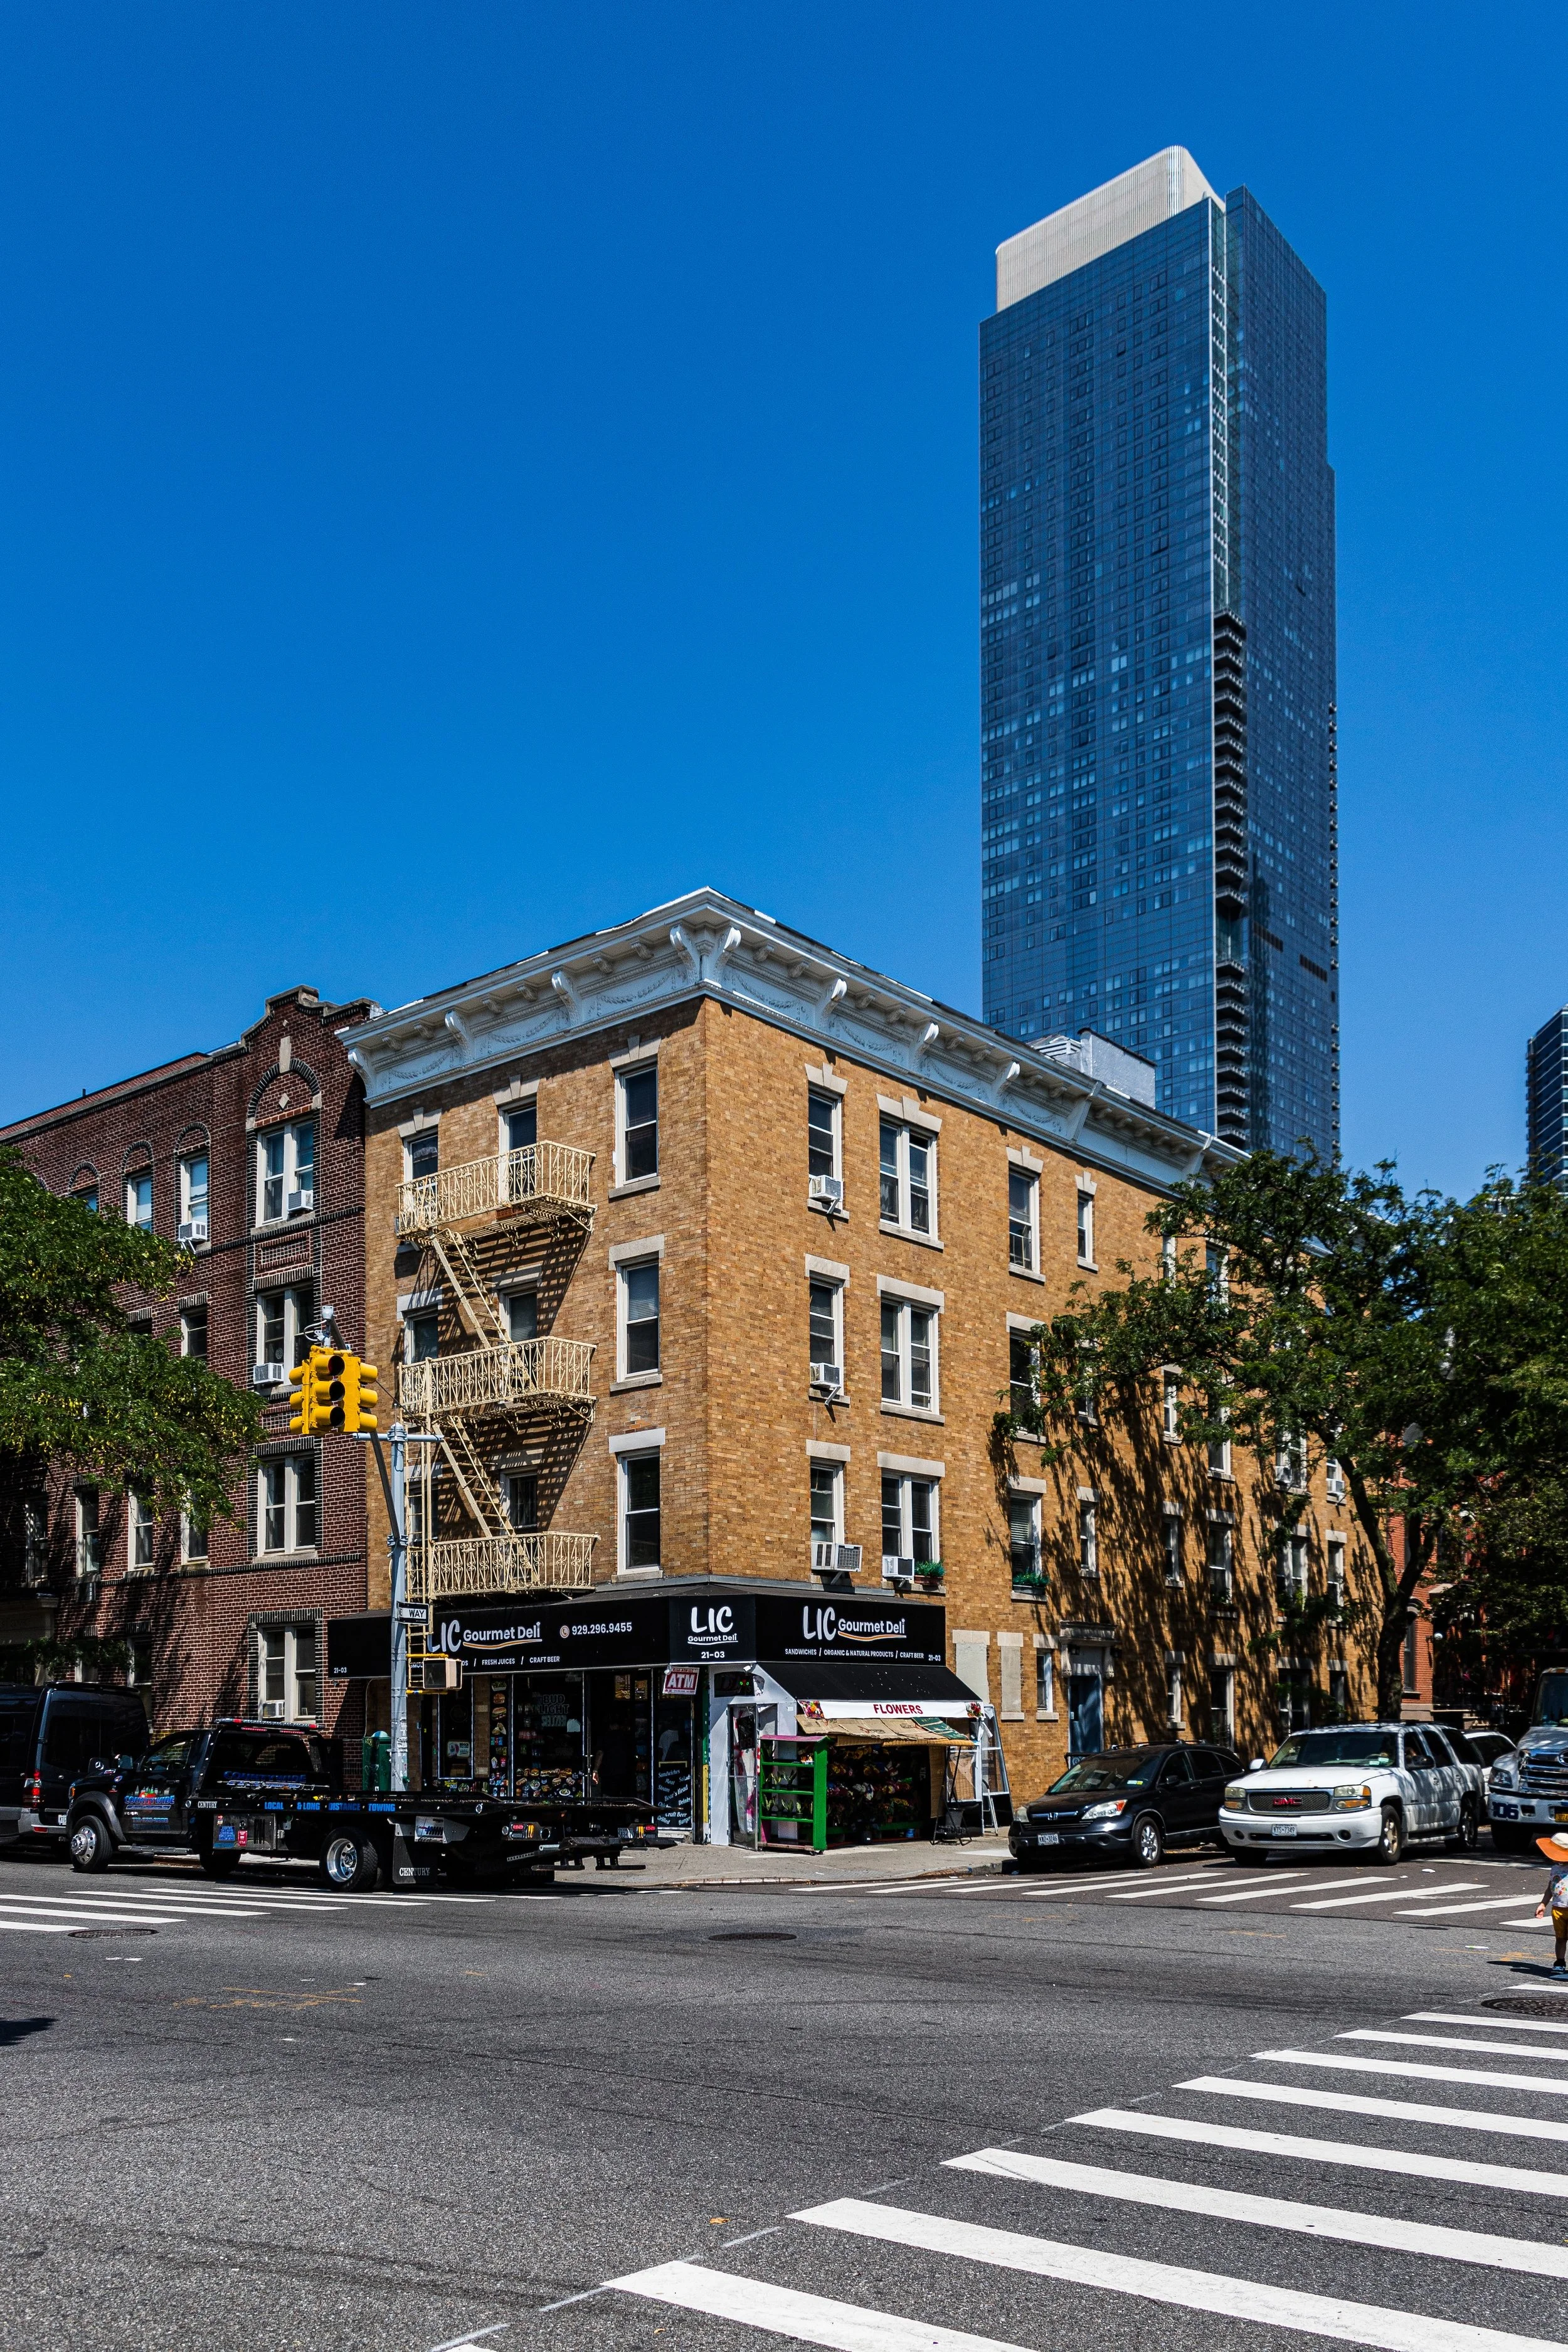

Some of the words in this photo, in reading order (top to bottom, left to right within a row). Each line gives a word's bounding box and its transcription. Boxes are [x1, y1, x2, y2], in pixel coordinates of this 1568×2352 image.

[409, 1609, 425, 1618] WAY
[691, 1606, 733, 1633] LIC
[571, 1622, 632, 1635] 929.296.9455
[803, 1606, 836, 1641] LIC
[838, 1618, 884, 1633] Gourmet
[886, 1618, 906, 1634] Deli
[428, 1620, 462, 1652] LIC
[464, 1629, 516, 1641] Gourmet
[517, 1622, 541, 1639] Deli
[667, 1673, 695, 1688] ATM
[873, 1704, 923, 1714] FLOWERS
[328, 1803, 361, 1811] DISTANCE
[368, 1803, 395, 1811] TOWING
[400, 1867, 430, 1876] CENTURY
